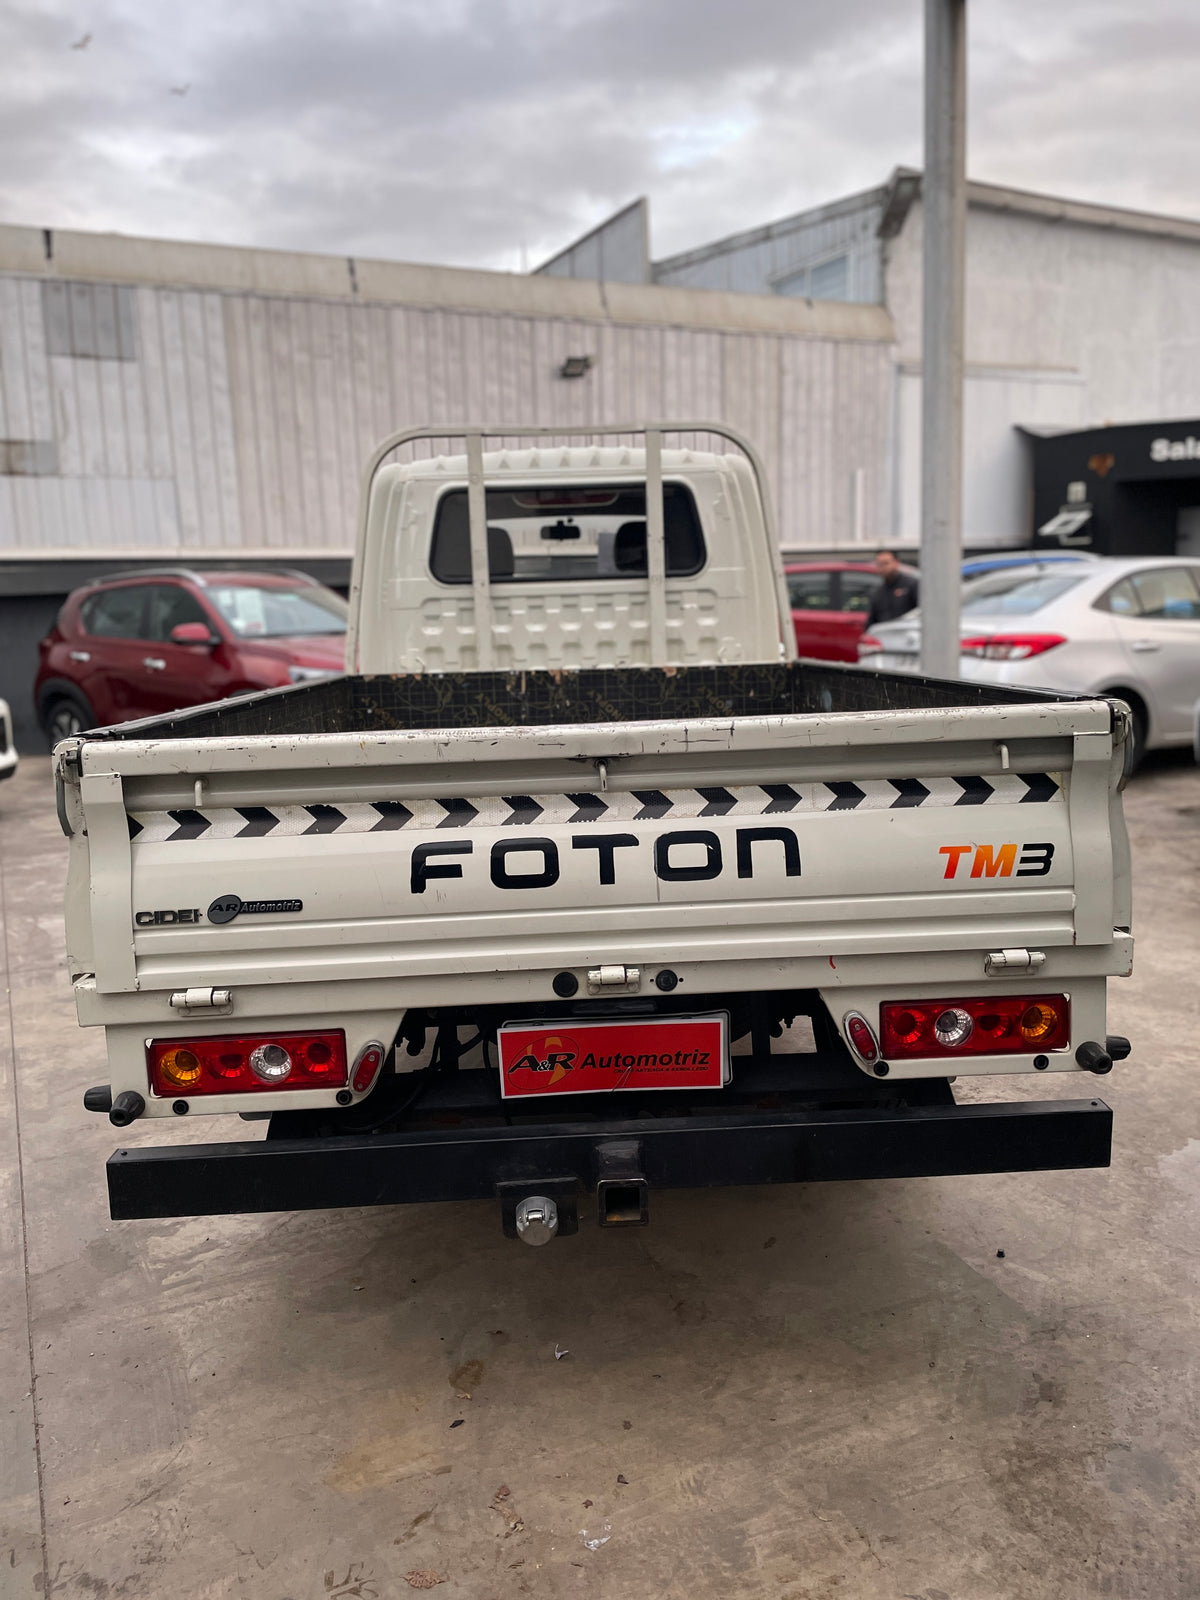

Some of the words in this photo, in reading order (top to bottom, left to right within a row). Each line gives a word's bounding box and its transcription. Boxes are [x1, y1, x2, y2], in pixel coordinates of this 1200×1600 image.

[410, 827, 801, 894] FOTON
[938, 843, 1055, 879] TM3
[240, 901, 300, 913] Automotriz
[508, 1052, 577, 1073] A&R
[580, 1049, 711, 1070] Automotriz
